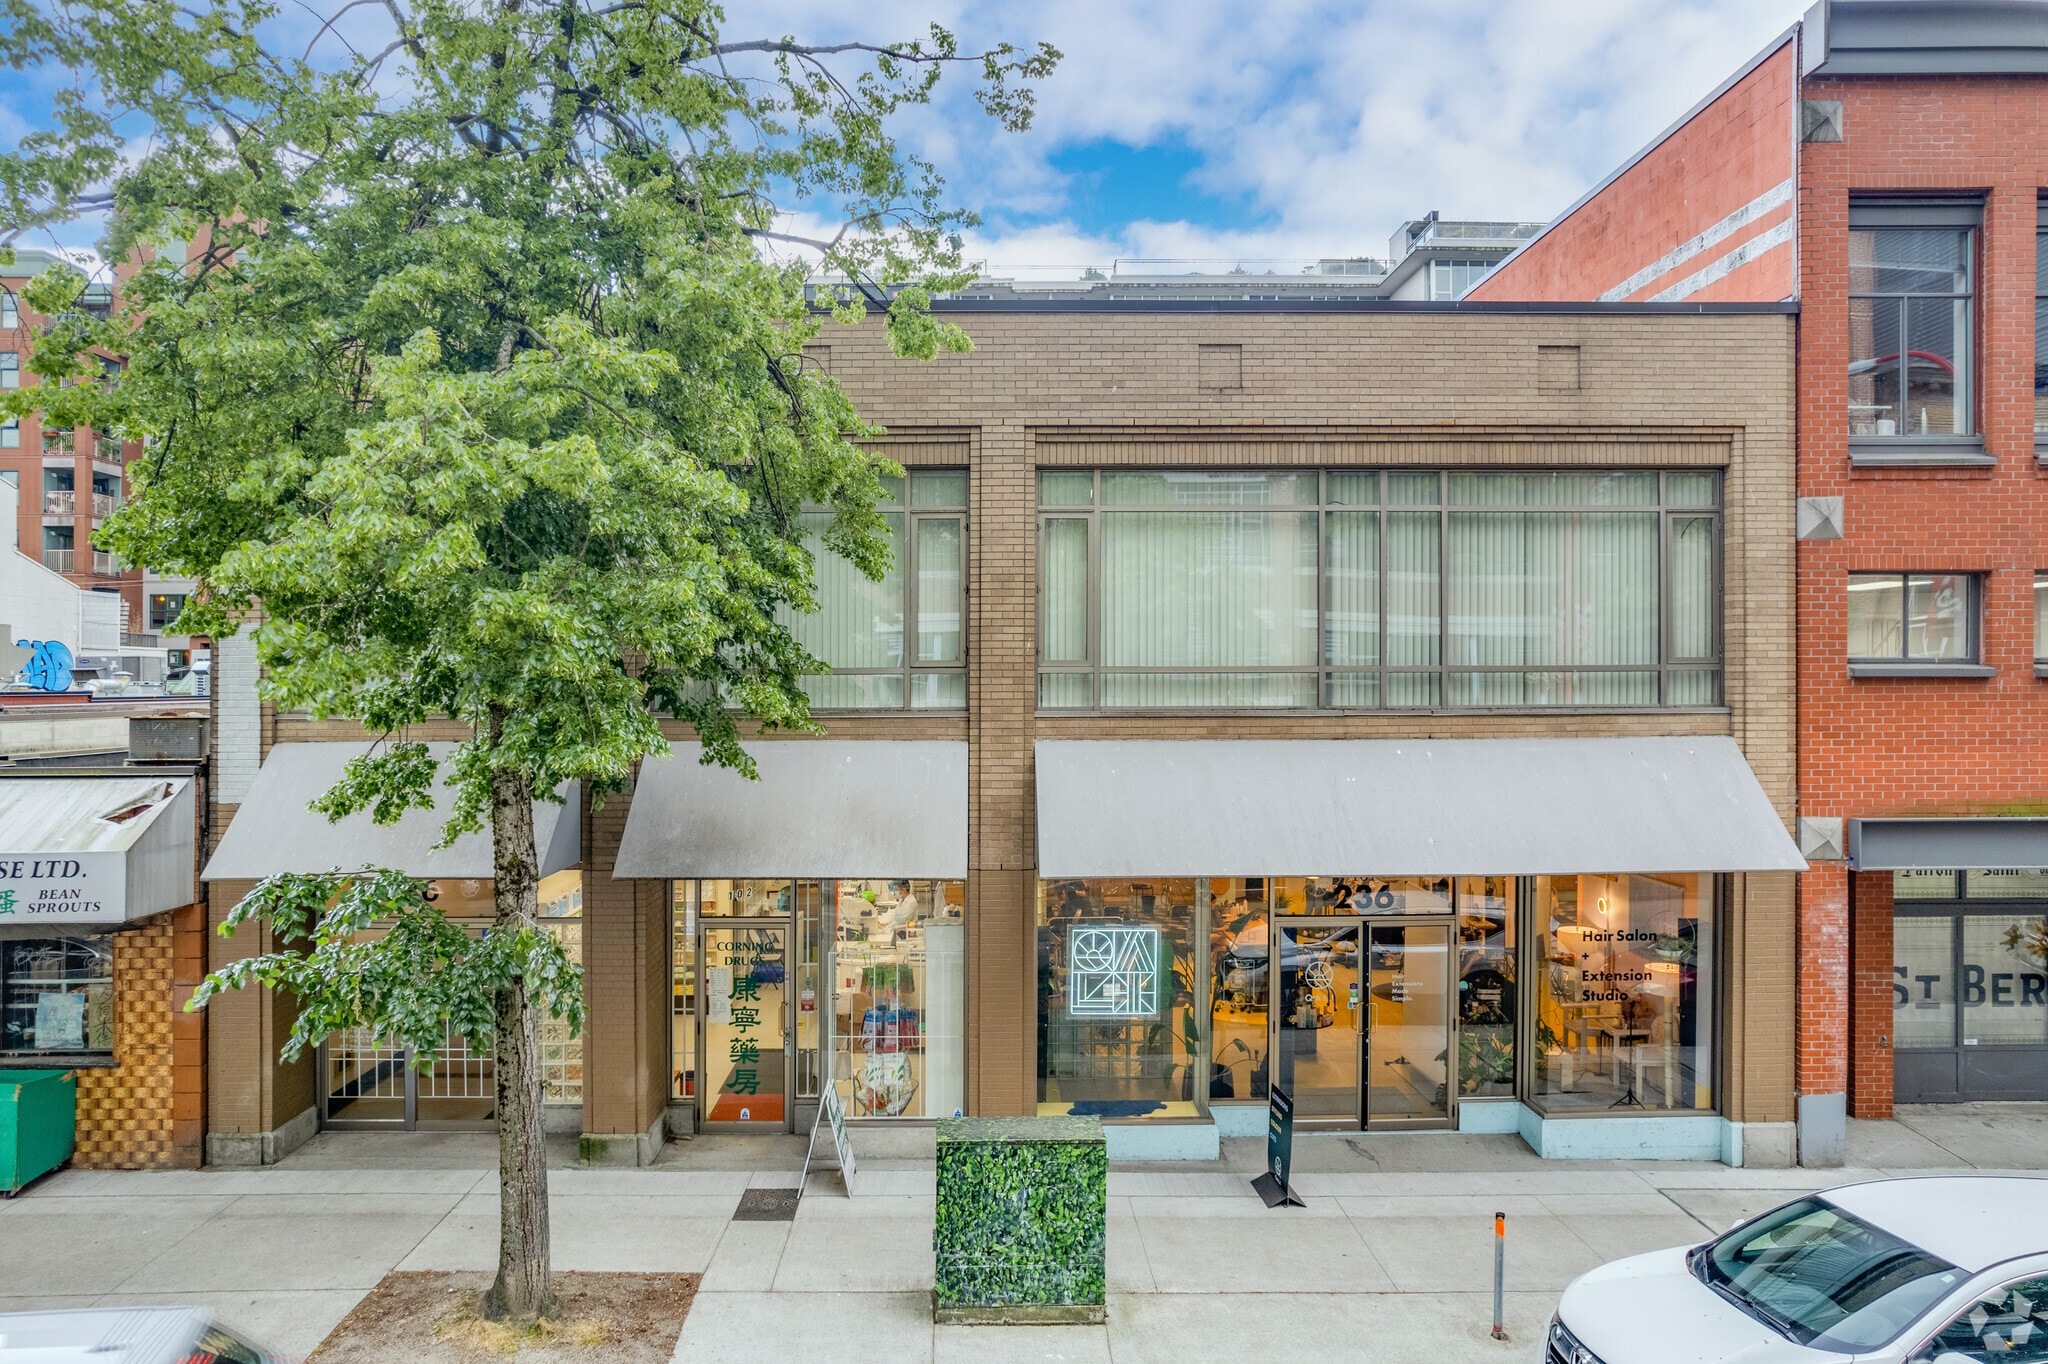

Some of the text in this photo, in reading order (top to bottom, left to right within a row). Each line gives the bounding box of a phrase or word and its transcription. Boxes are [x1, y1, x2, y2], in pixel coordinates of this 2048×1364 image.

[30, 860, 87, 879] LTD.
[39, 888, 82, 900] BEAN
[728, 887, 753, 900] 102
[1334, 884, 1395, 909] 236
[27, 901, 101, 914] SPROUTS
[1582, 928, 1657, 942] Hair Salon
[716, 941, 774, 952] CORNING
[724, 956, 765, 967] DRUGS
[1582, 968, 1653, 982] Extension
[1582, 988, 1629, 1002] Studio
[727, 975, 761, 1095] 康寧藥房
